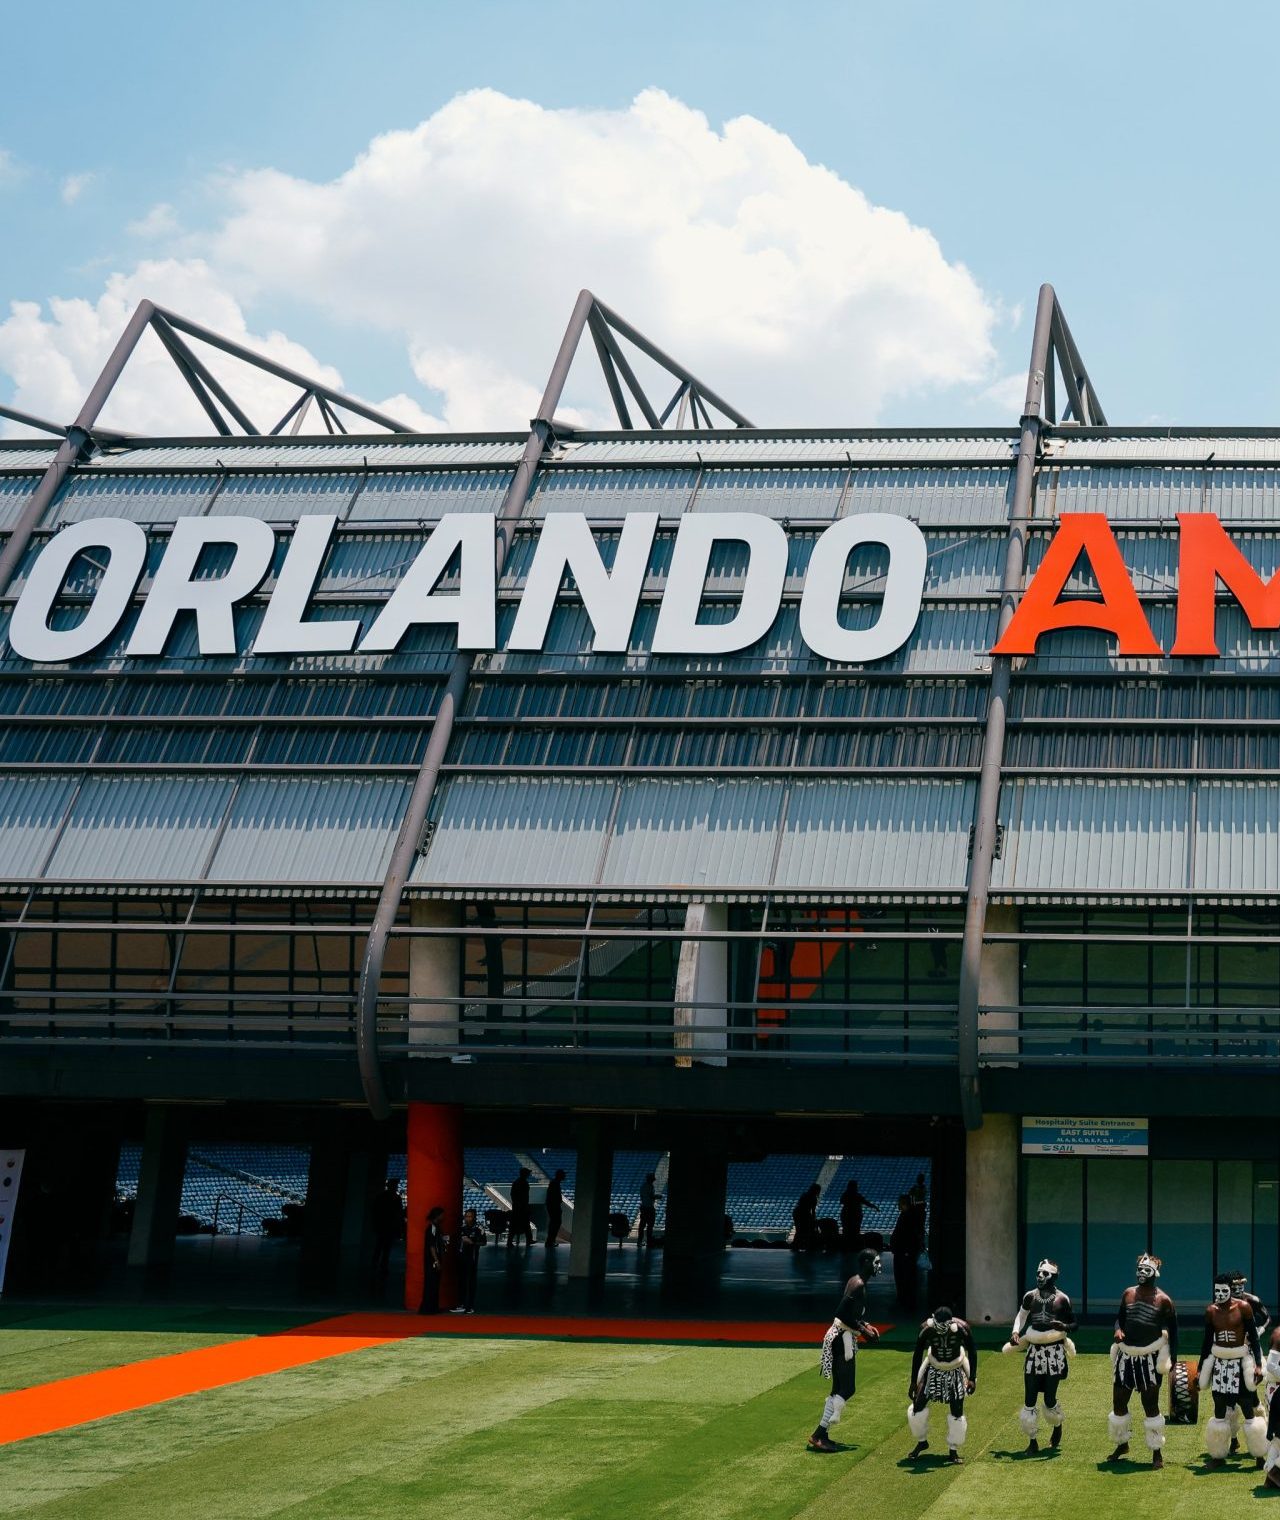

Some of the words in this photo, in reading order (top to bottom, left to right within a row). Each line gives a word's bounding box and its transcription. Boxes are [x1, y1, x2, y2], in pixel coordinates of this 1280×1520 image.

[7, 512, 927, 662] ORLANDO
[1035, 1119, 1077, 1127] Hospitality
[1079, 1119, 1098, 1127] Suite
[1101, 1119, 1136, 1127] Entrance
